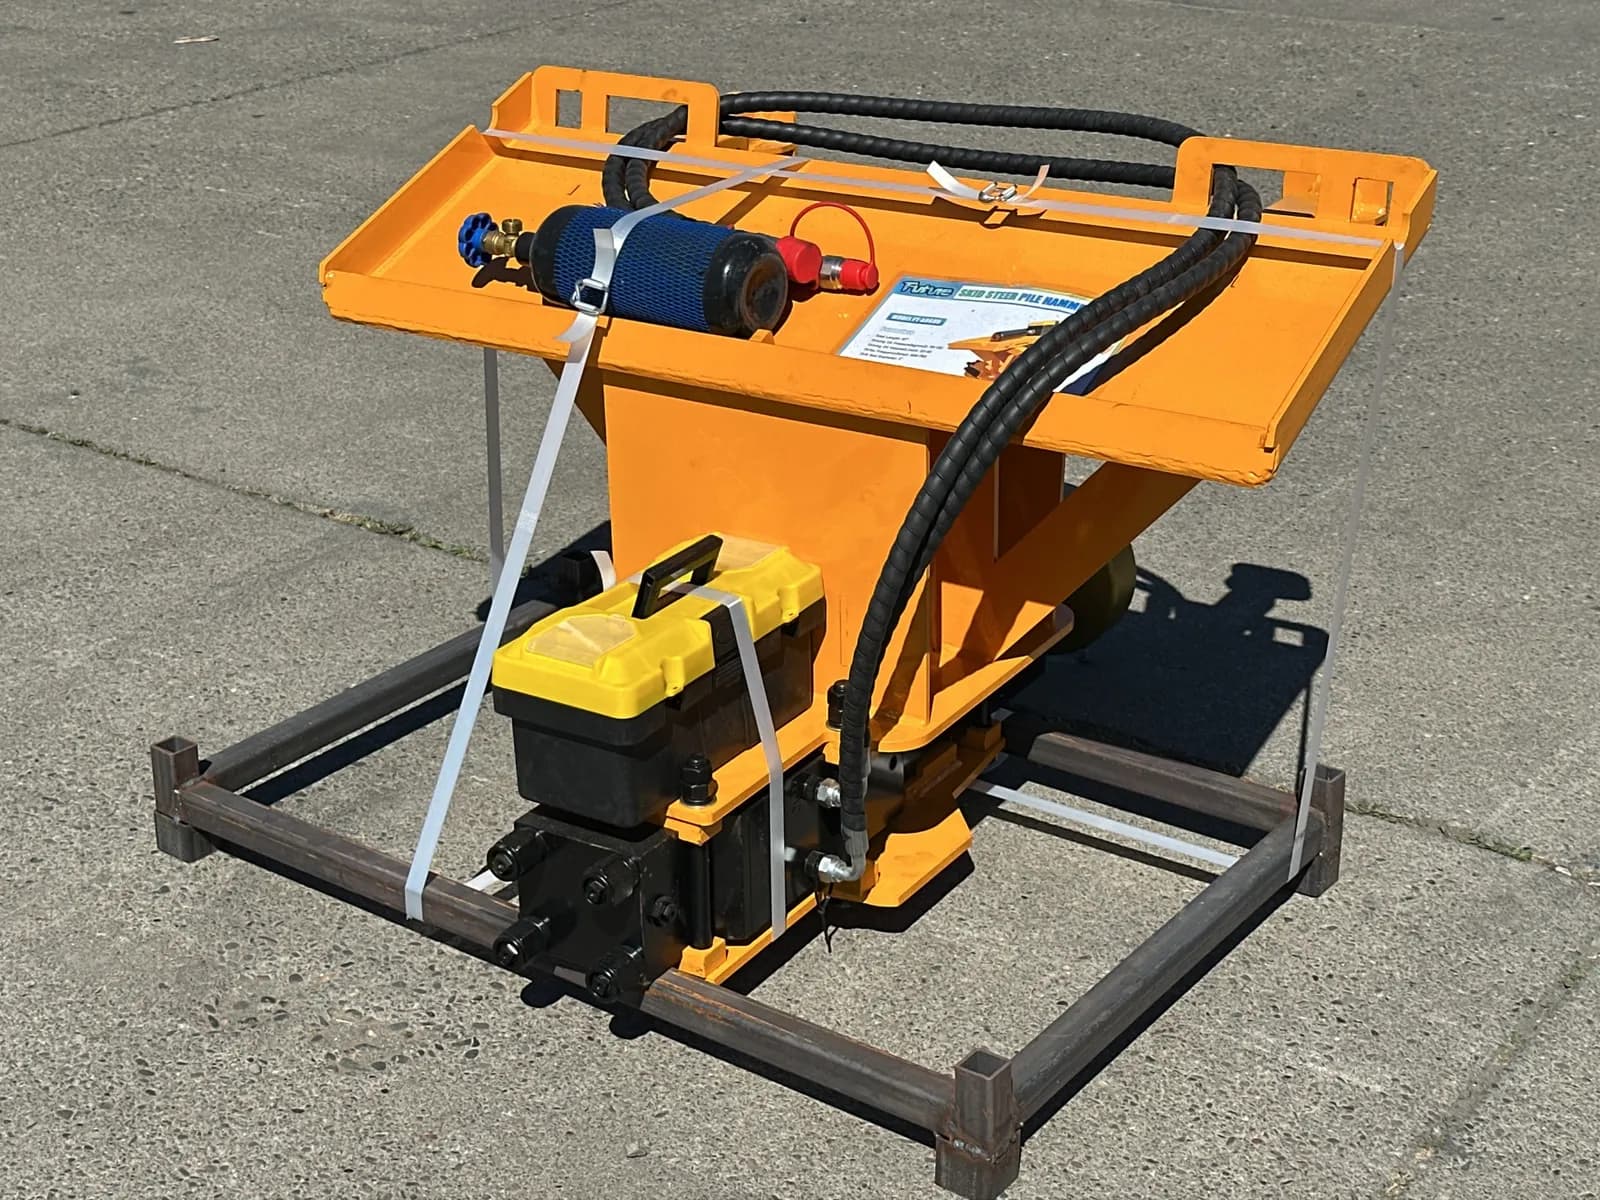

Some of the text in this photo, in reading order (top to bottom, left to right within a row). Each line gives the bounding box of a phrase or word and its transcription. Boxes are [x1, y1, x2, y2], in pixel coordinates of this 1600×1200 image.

[958, 288, 985, 299] SKID
[985, 290, 1019, 301] STEER
[1017, 292, 1044, 304] PILE
